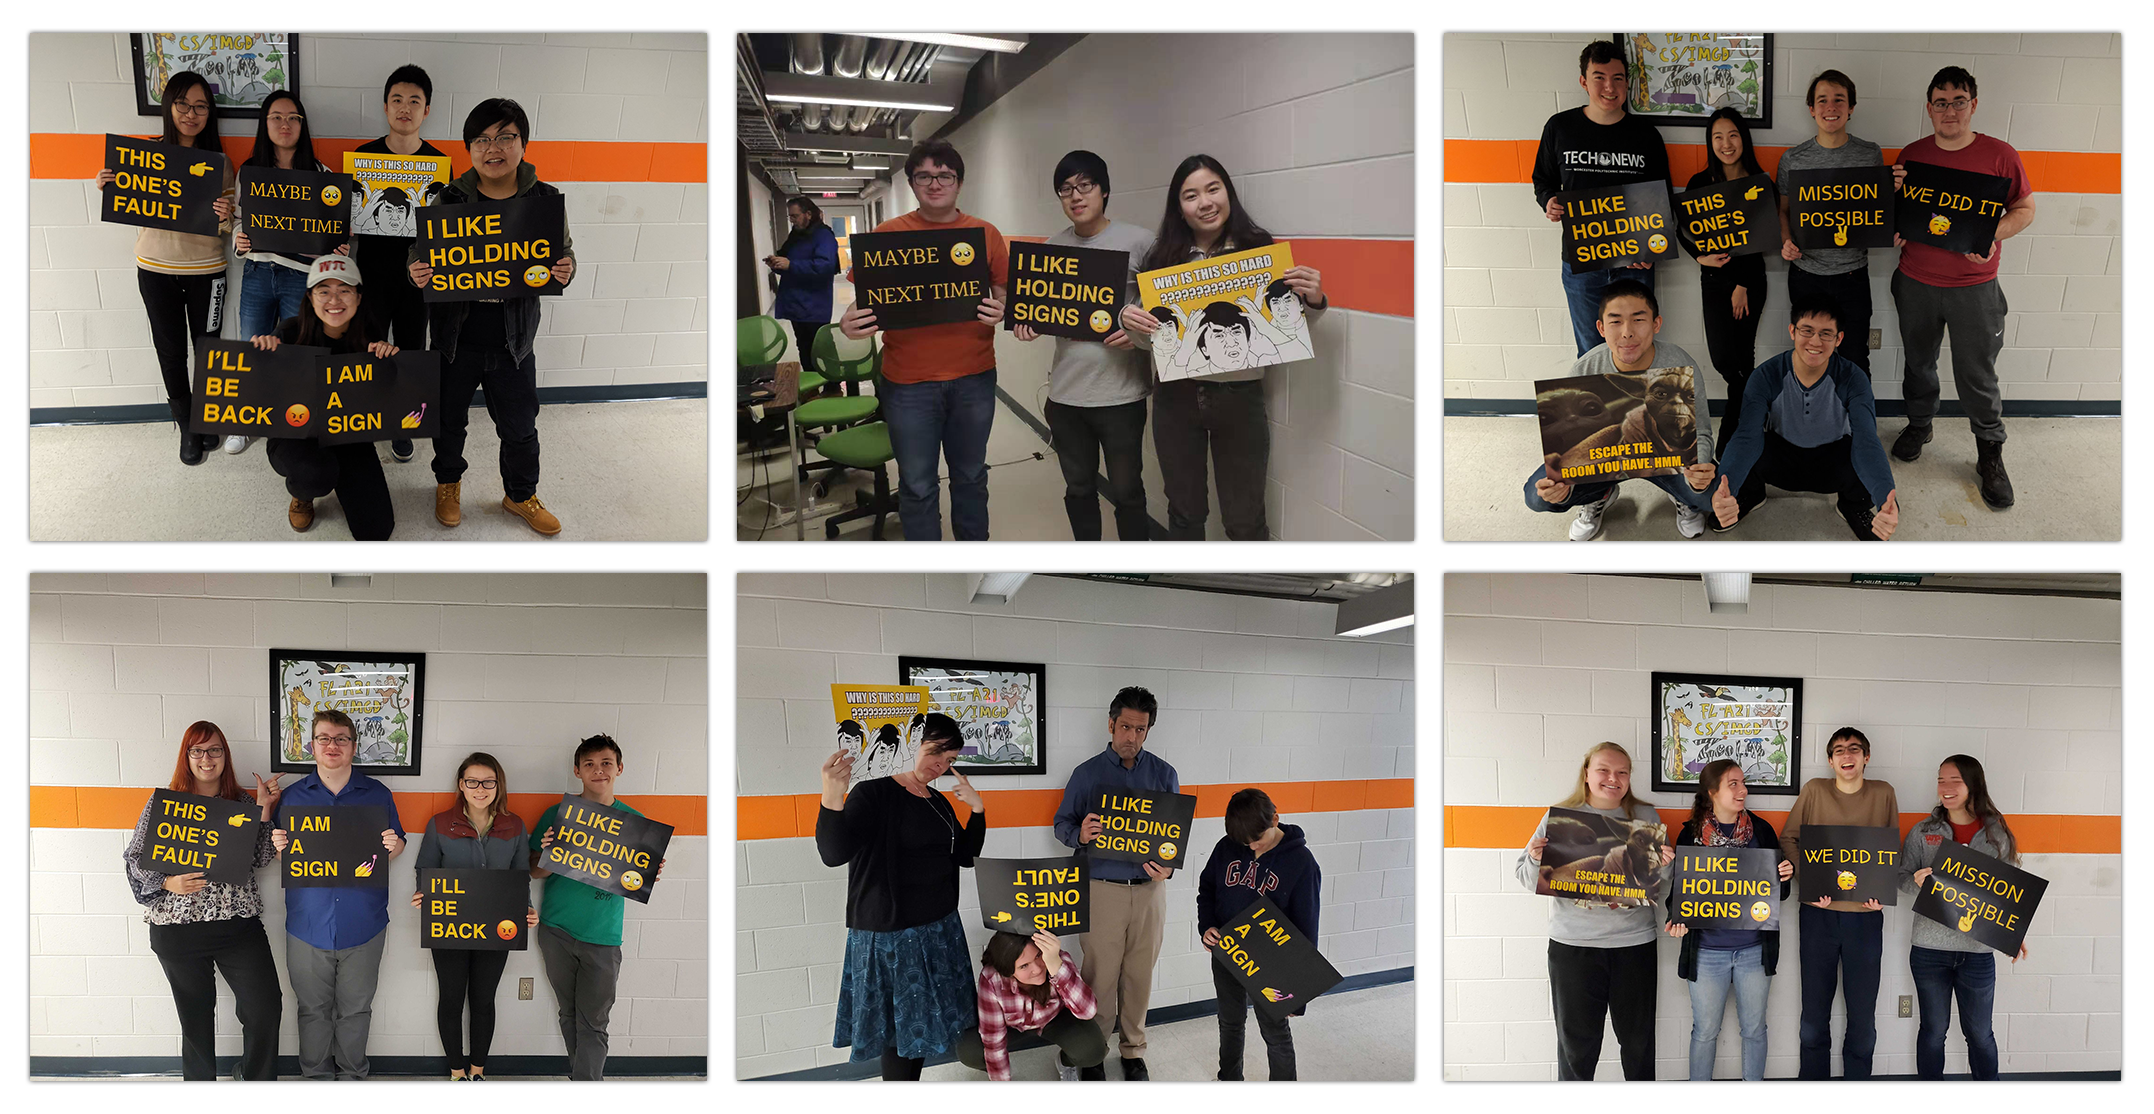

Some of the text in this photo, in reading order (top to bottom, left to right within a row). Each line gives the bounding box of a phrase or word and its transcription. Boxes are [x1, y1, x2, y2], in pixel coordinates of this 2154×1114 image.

[178, 34, 253, 52] CS/IMGD
[1659, 46, 1730, 63] CS/IMGD
[116, 147, 165, 170] THIS
[354, 158, 438, 172] WHY IS THIS SO HARD
[1563, 151, 1646, 168] TECH NEWS
[250, 182, 311, 200] MAYBE
[1799, 184, 1878, 202] MISSION
[1903, 184, 2003, 217] WE DID IT
[114, 196, 182, 220] FAULT
[1567, 196, 1626, 217] I LIKE
[1682, 194, 1725, 215] THIS
[251, 214, 342, 234] NEXT TIME
[427, 214, 502, 239] I LIKE
[1572, 213, 1664, 240] HOLDING
[1800, 210, 1884, 227] POSSIBLE
[1577, 239, 1639, 262] SIGNS
[1695, 230, 1749, 252] FAULT
[430, 239, 550, 267] HOLDING
[863, 247, 940, 268] MAYBE
[1018, 254, 1079, 275] I LIKE
[1152, 254, 1273, 290] WHY IS THIS SO HARD
[432, 270, 510, 291] SIGNS
[1015, 278, 1115, 304] HOLDING
[869, 281, 980, 305] NEXT TIME
[211, 283, 225, 328] Supreme
[1014, 303, 1079, 326] SIGNS
[326, 364, 372, 384] I AM
[206, 376, 240, 397] BE
[326, 392, 343, 410] A
[204, 403, 274, 426] BACK
[328, 412, 382, 434] SIGN
[1589, 442, 1654, 460] ESCAPE THE
[1561, 456, 1684, 478] ROOM YOU HAVE. HMM.
[845, 692, 920, 704] WHY IS THIS SO HARD
[1700, 703, 1750, 720] FL-A21
[1695, 721, 1762, 736] CS/IMGD
[163, 799, 206, 821] THIS
[1102, 794, 1153, 814] I LIKE
[290, 816, 330, 831] I AM
[565, 805, 623, 836] I LIKE
[1100, 815, 1180, 838] HOLDING
[290, 839, 304, 854] A
[558, 826, 650, 868] HOLDING
[1096, 834, 1150, 854] SIGNS
[152, 844, 217, 868] FAULT
[550, 846, 612, 879] SIGNS
[1684, 856, 1738, 872] I LIKE
[1805, 849, 1897, 865] WE DID IT
[290, 861, 337, 877] SIGN
[1013, 867, 1080, 886] FAULT
[1225, 860, 1279, 896] GAP
[1575, 870, 1626, 884] ESCAPE THE
[1550, 880, 1577, 892] ROOM
[1580, 883, 1597, 894] YOU
[1623, 888, 1648, 899] HMM.
[1682, 878, 1771, 896] HOLDING
[1941, 857, 2024, 903] MISSION
[432, 900, 457, 916] BE
[1680, 901, 1741, 918] SIGNS
[1931, 880, 2019, 931] POSSIBLE
[431, 922, 486, 939] BACK
[1034, 911, 1080, 930] THIS
[1252, 908, 1292, 946] I AM
[1234, 924, 1251, 939] A
[1219, 935, 1260, 977] SIGN
